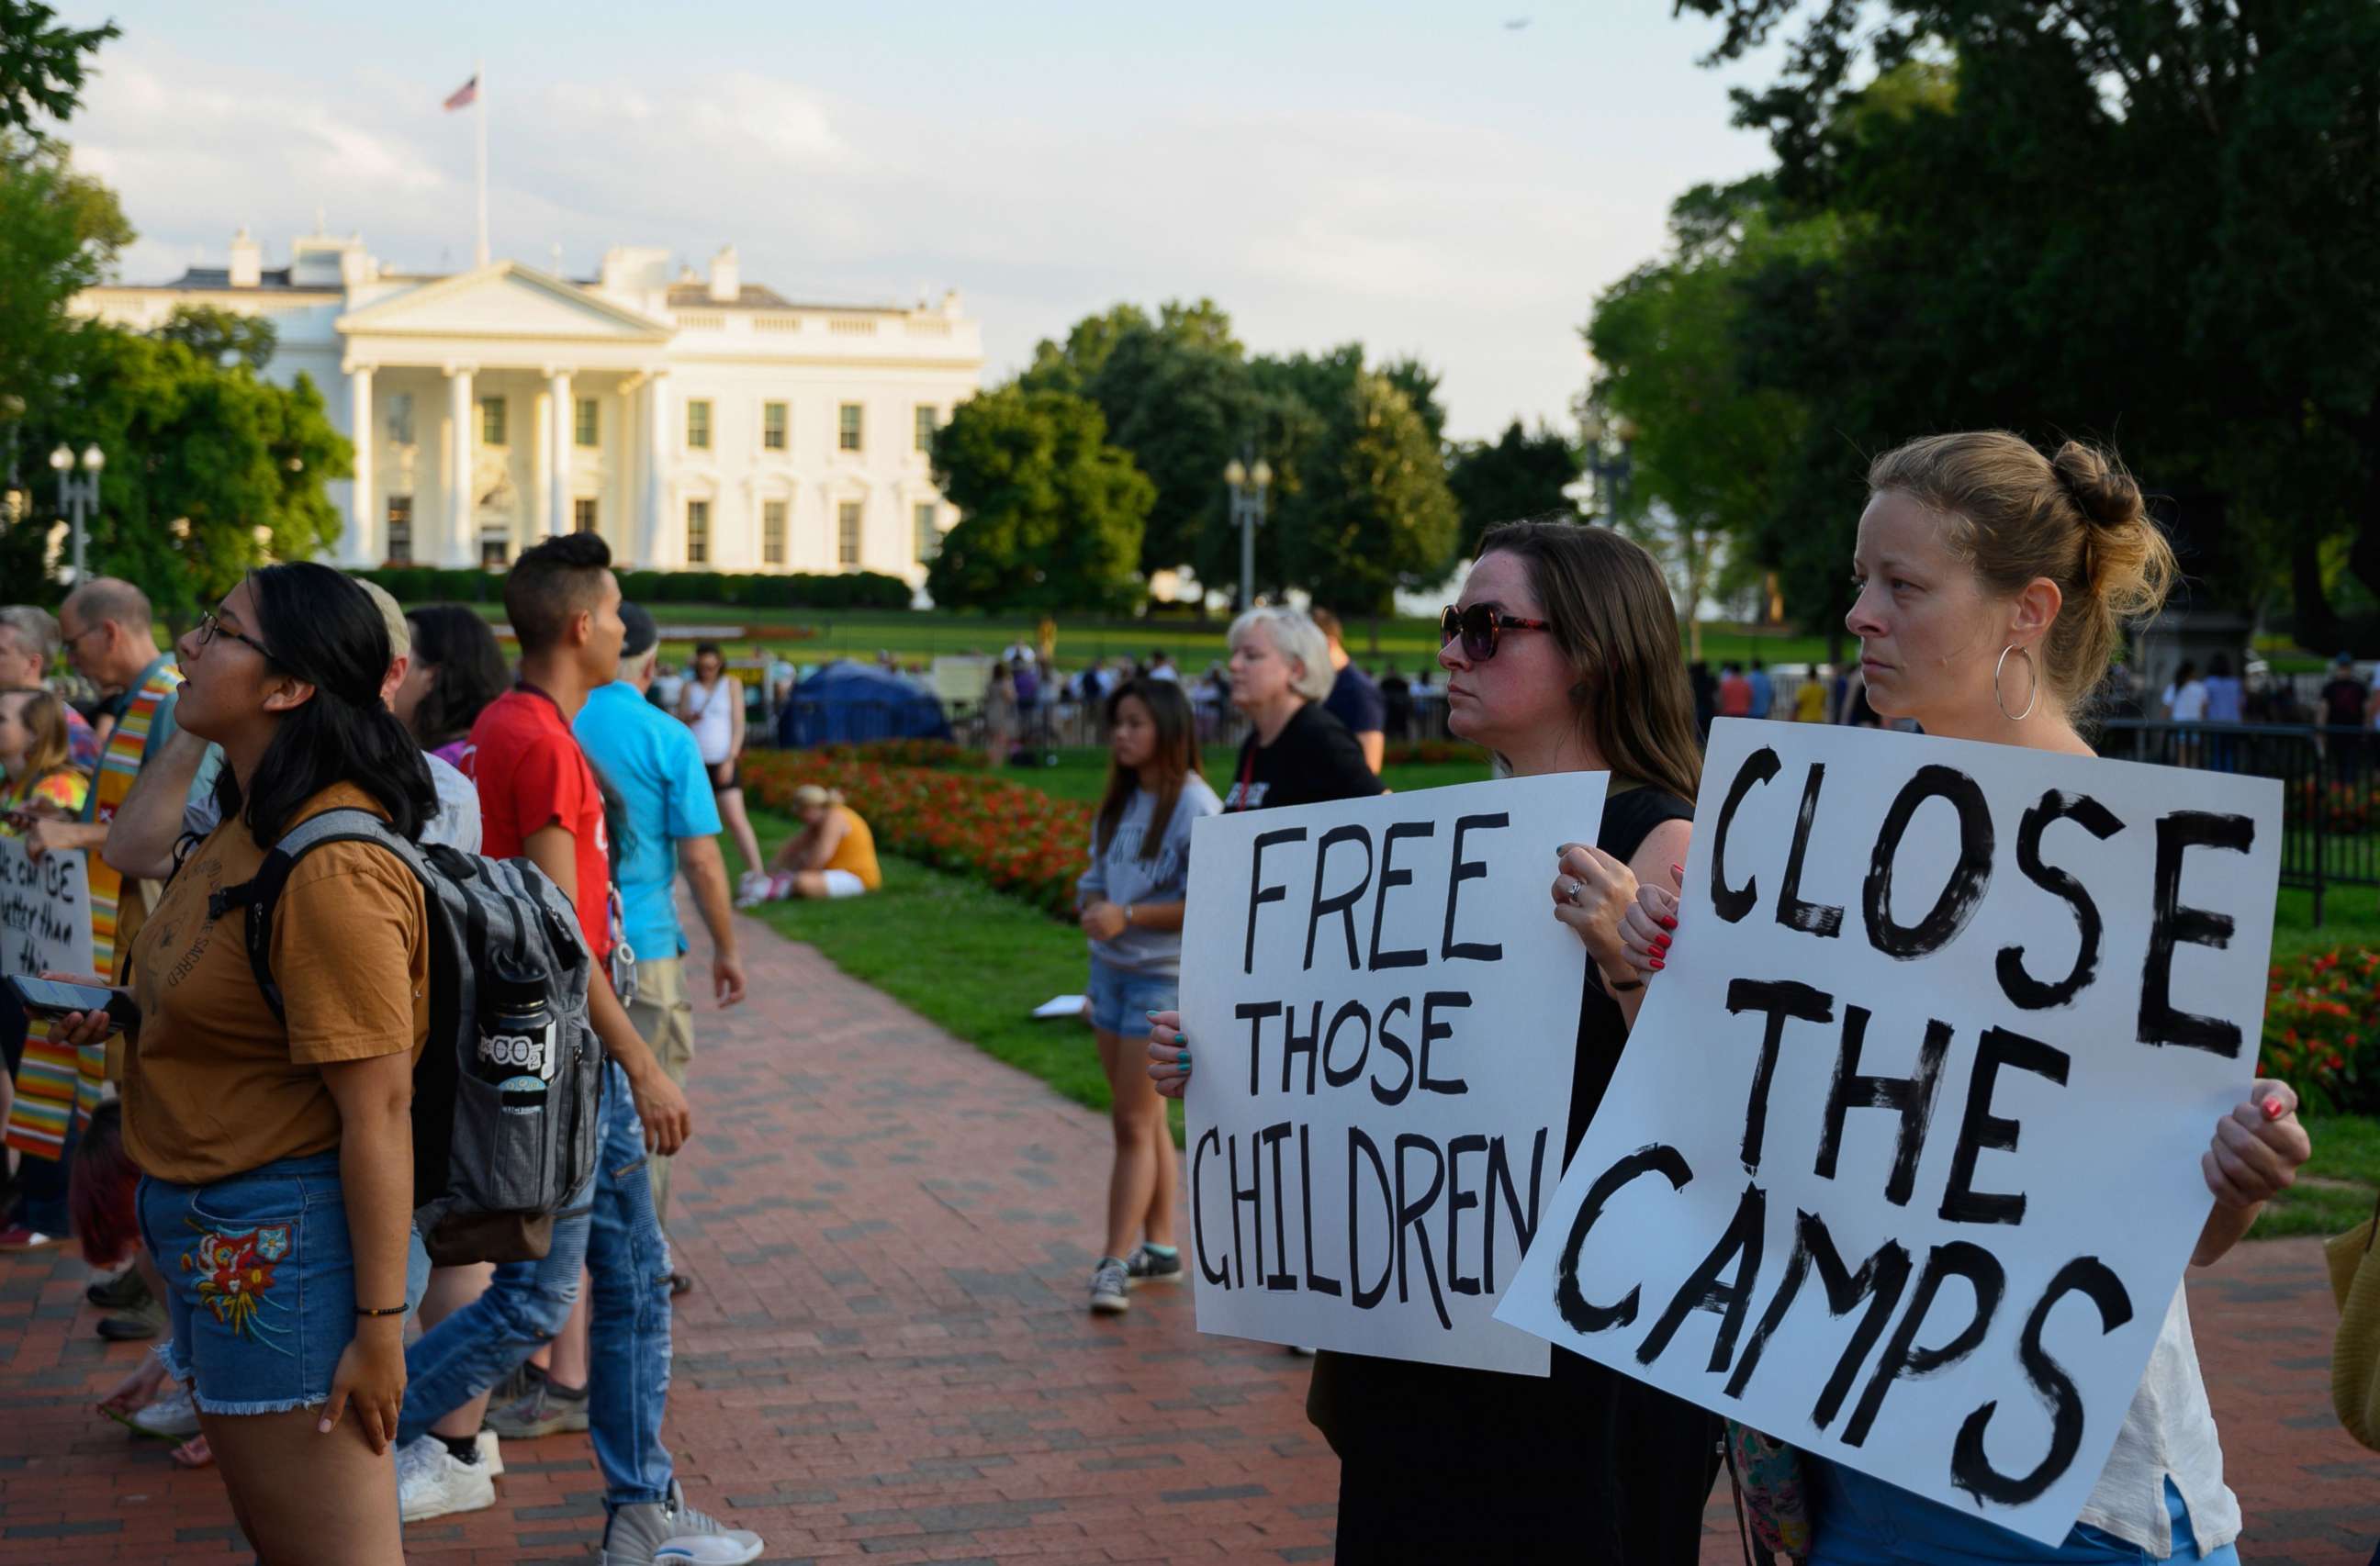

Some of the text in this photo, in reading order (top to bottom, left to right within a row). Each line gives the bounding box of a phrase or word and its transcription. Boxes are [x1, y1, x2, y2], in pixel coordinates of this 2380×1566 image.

[167, 938, 210, 988] SACRED
[1244, 812, 1510, 974] FREE
[1711, 745, 2255, 1058] CLOSE
[1235, 990, 1473, 1106] THOSE
[1726, 979, 2071, 1226] THE
[1194, 1121, 1547, 1330] CHILDREN
[1555, 1143, 2133, 1508] CAMPS
